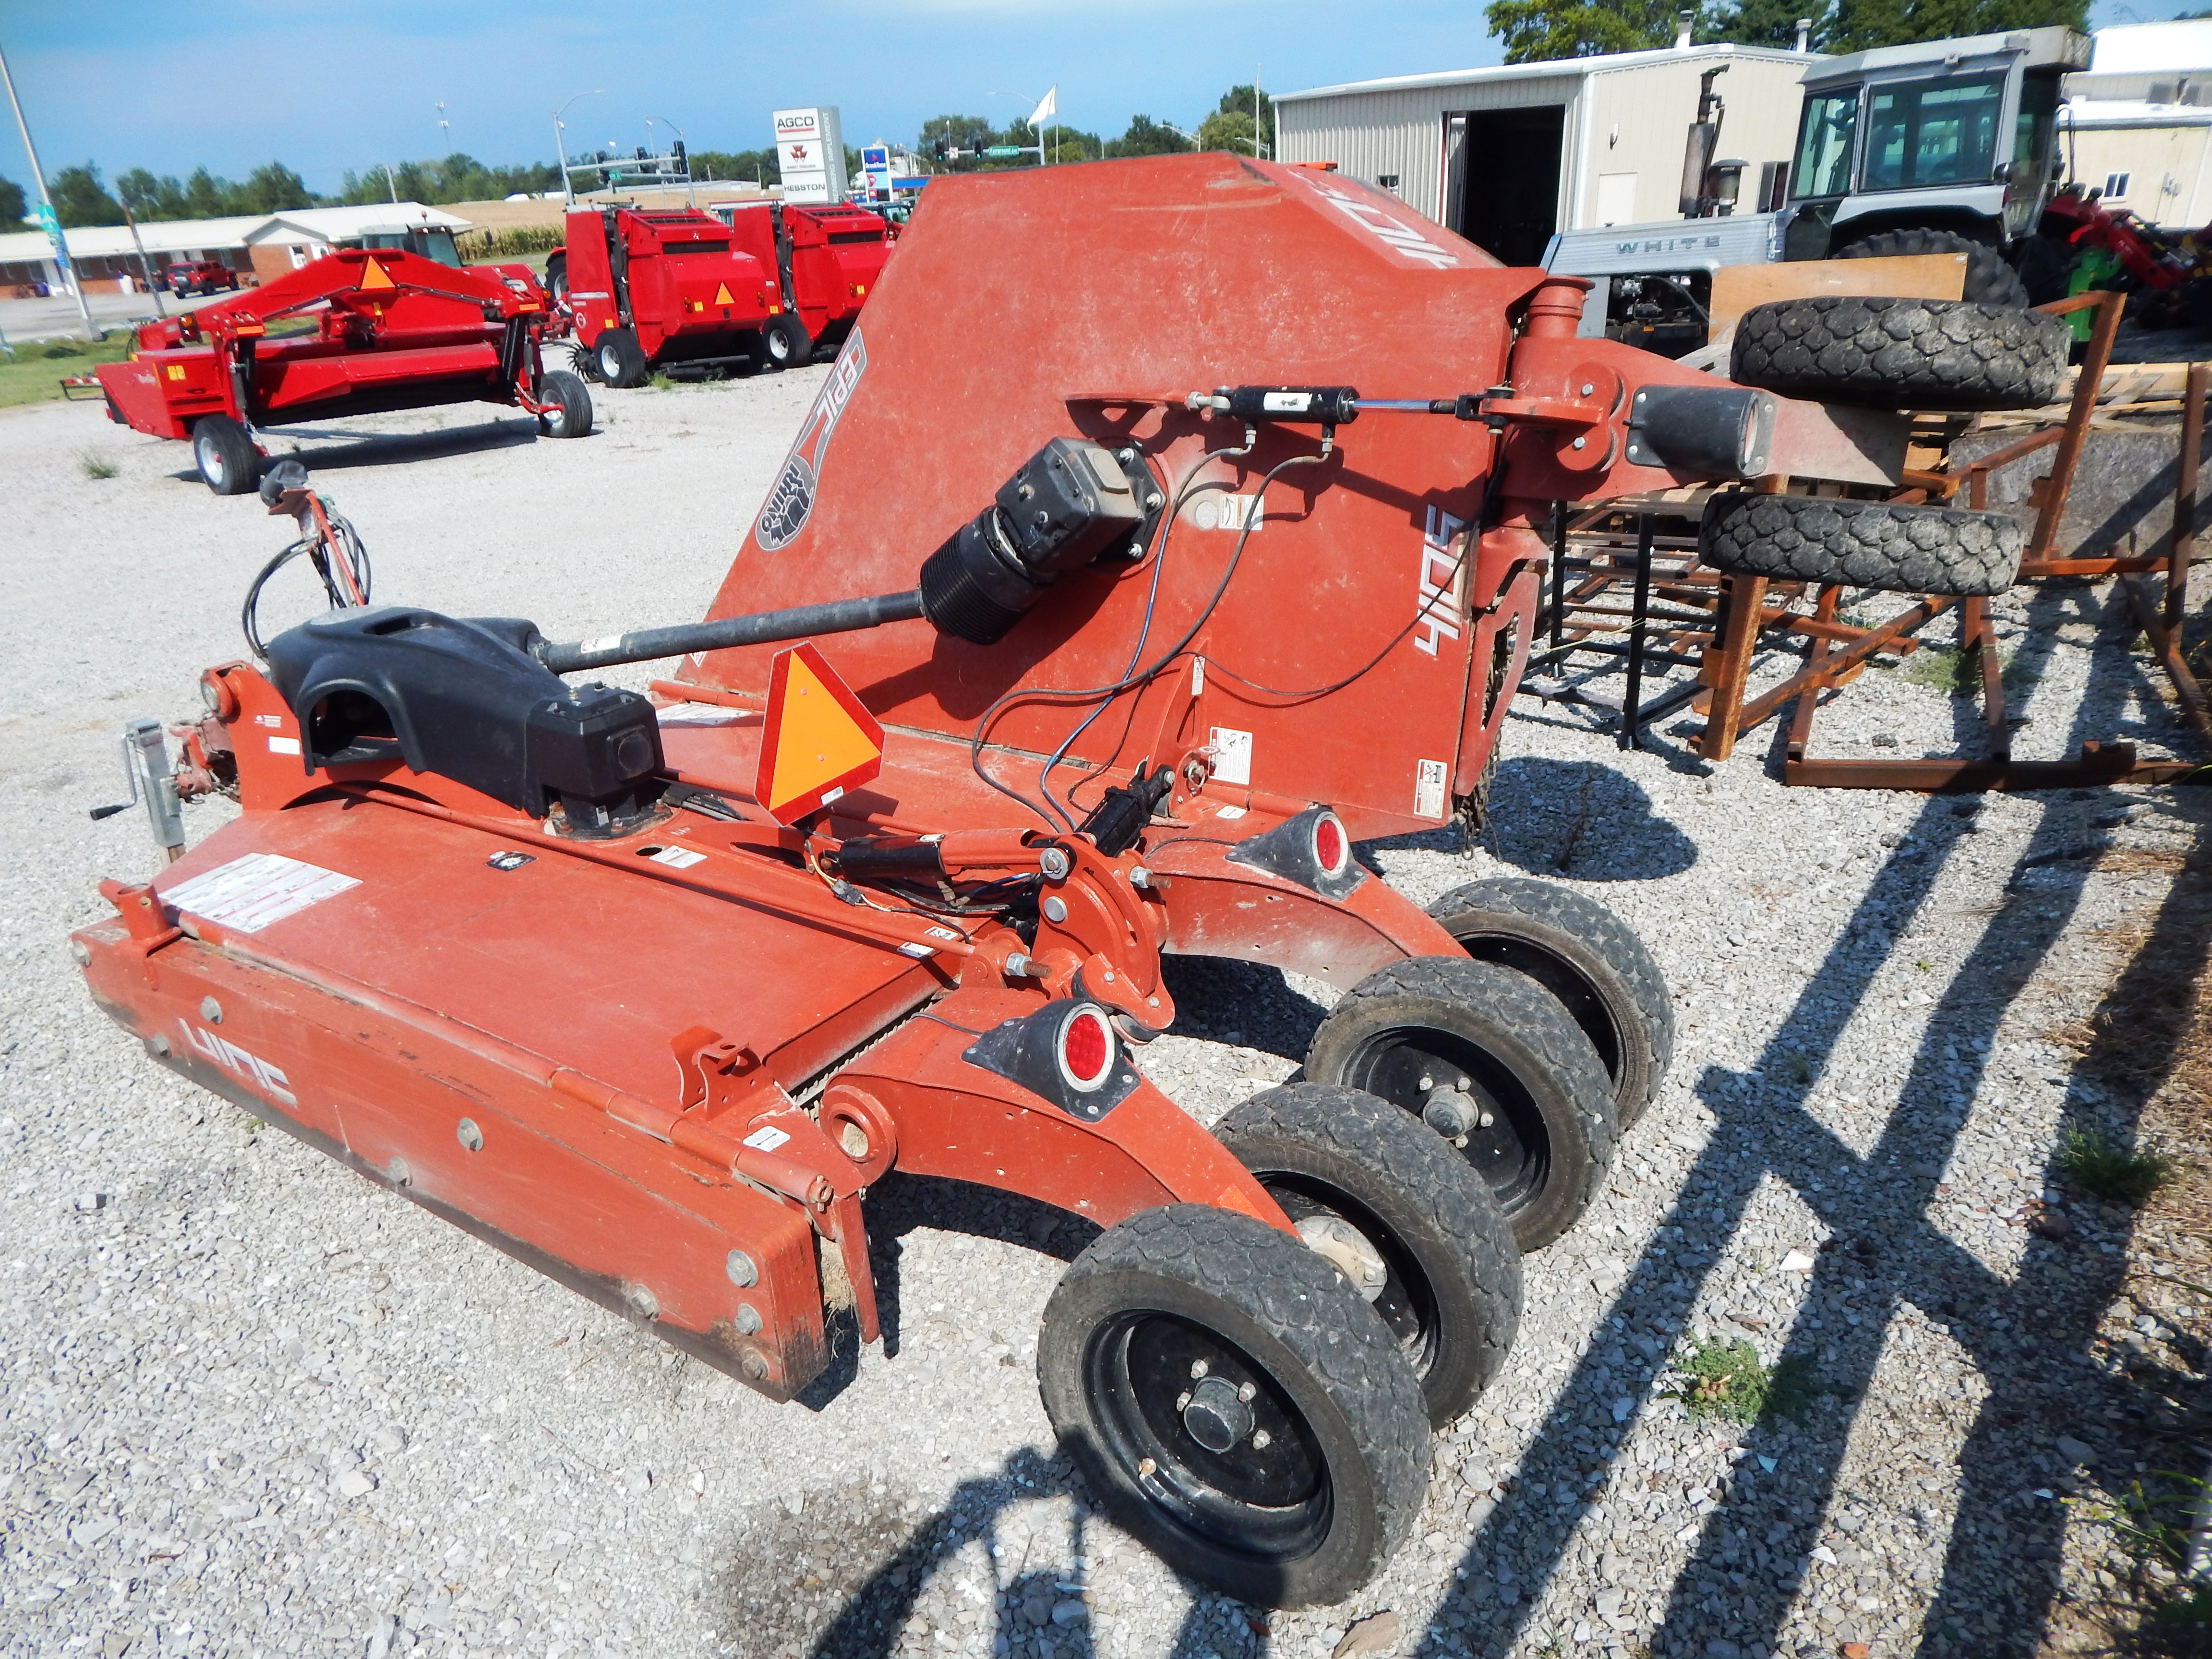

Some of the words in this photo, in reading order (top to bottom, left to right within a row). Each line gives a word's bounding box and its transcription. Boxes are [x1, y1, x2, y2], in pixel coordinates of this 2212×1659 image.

[777, 116, 814, 128] AGCO
[823, 112, 834, 161] IMPLEMENT
[784, 183, 825, 192] HESSTON
[1616, 235, 1721, 254] WHITE
[813, 352, 858, 434] EPIC
[760, 461, 805, 533] RHINO
[1414, 504, 1468, 656] 4105
